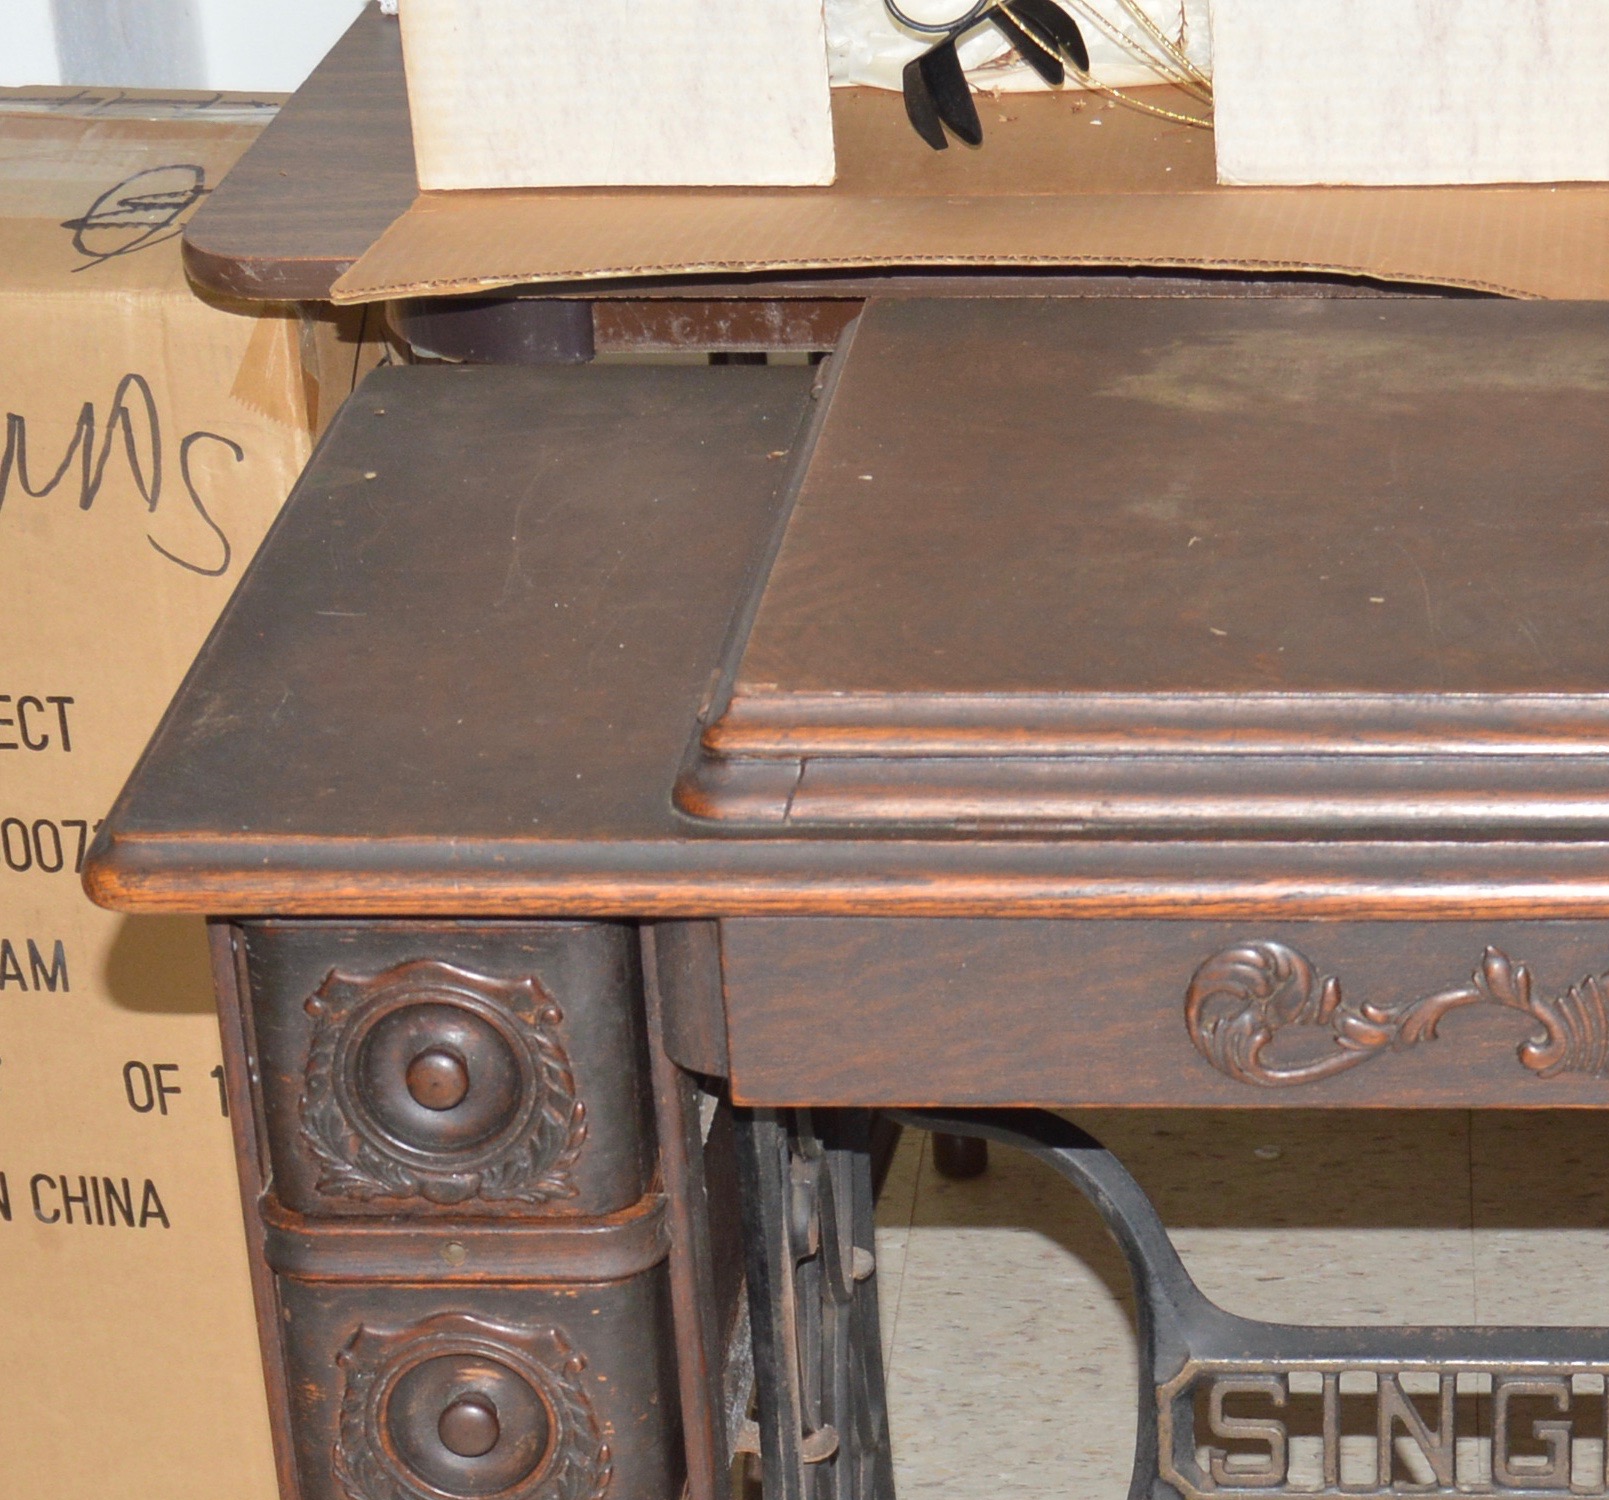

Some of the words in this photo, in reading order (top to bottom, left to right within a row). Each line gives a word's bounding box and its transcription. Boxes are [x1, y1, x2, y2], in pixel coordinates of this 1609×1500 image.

[1, 817, 104, 874] 007
[122, 1060, 181, 1116] OF
[29, 1173, 170, 1229] CHINA
